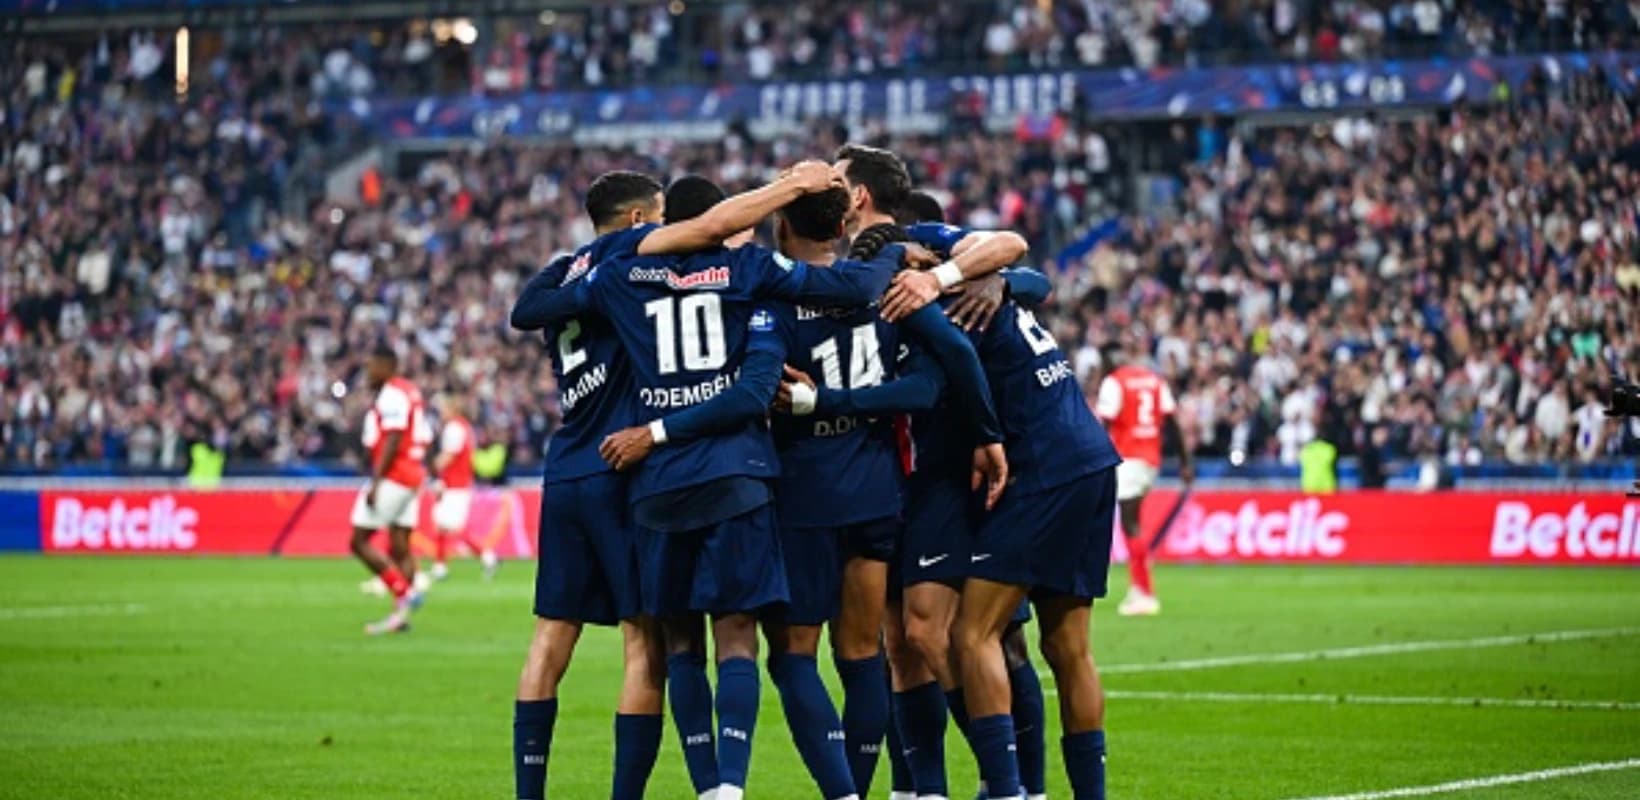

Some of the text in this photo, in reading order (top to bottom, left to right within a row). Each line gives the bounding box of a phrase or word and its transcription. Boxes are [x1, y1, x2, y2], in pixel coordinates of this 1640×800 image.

[557, 318, 588, 376] 2
[645, 291, 728, 376] 10
[810, 321, 885, 390] 14
[1136, 390, 1156, 426] 2
[53, 494, 199, 550] Betclic
[1166, 498, 1350, 557] Betclic
